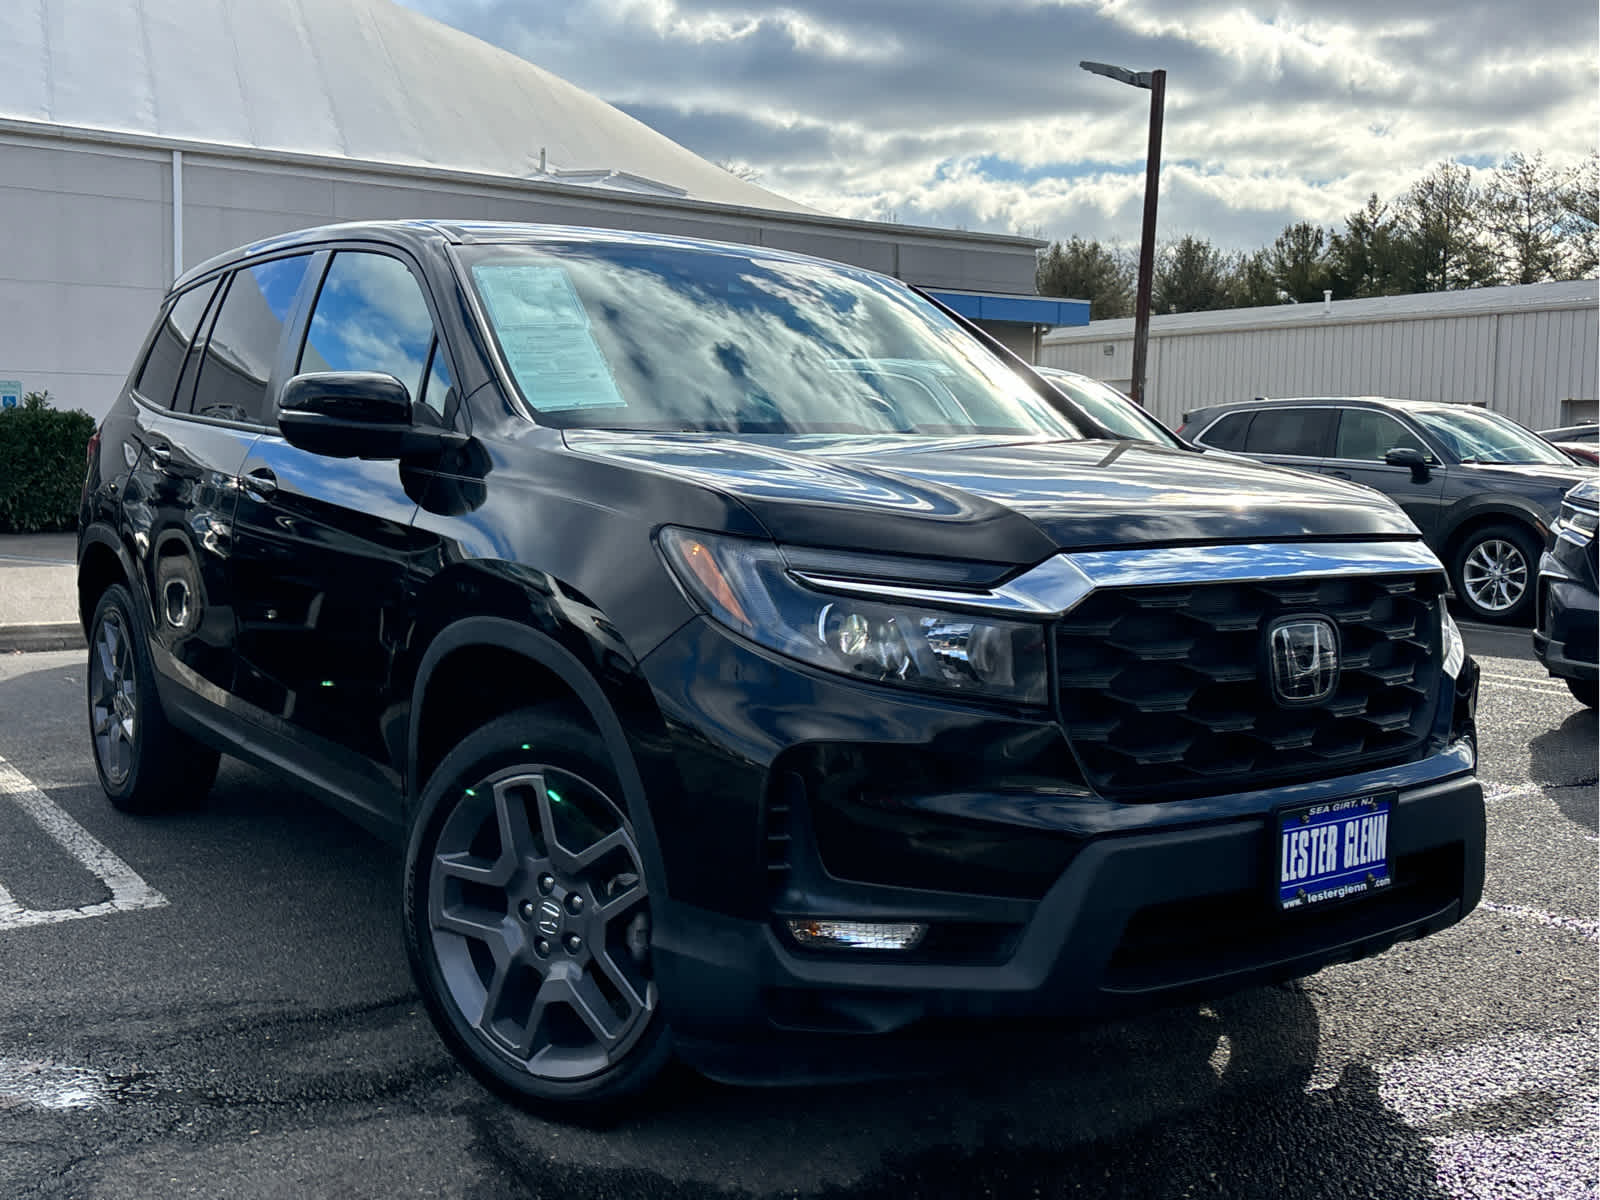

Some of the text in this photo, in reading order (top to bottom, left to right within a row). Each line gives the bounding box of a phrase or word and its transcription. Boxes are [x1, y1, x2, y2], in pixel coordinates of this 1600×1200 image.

[1309, 804, 1330, 816] SEA
[1361, 797, 1374, 807] NJ
[1281, 814, 1388, 882] LESTER GLENN
[1308, 883, 1367, 903] lesterglenn
